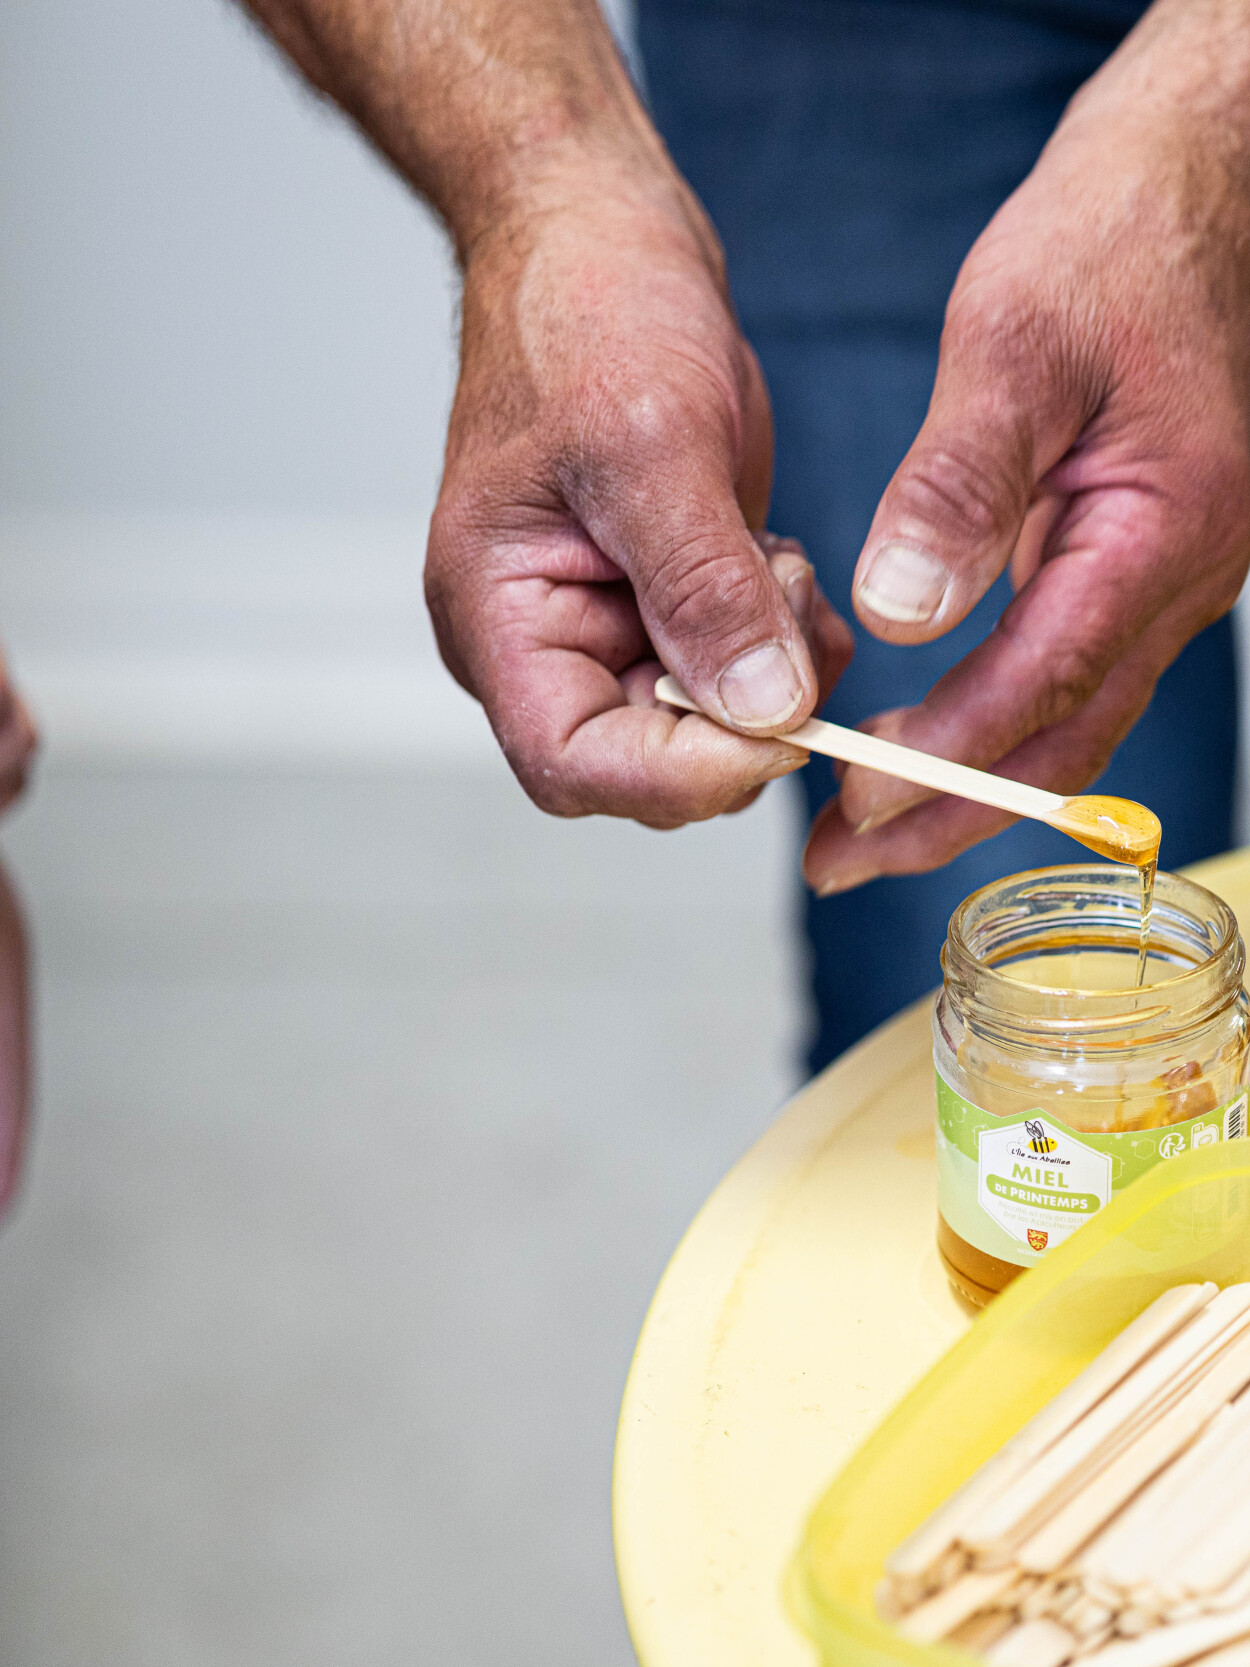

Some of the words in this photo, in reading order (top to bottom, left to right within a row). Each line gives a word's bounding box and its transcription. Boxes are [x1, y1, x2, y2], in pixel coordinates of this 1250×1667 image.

[1039, 1155, 1071, 1165] Abeilles
[1012, 1163, 1069, 1188] MIEL
[995, 1183, 1008, 1194] DE
[1010, 1186, 1088, 1209] PRINTEMPS
[1003, 1211, 1017, 1219] par
[1018, 1213, 1029, 1222] les
[1068, 1216, 1083, 1224] pot
